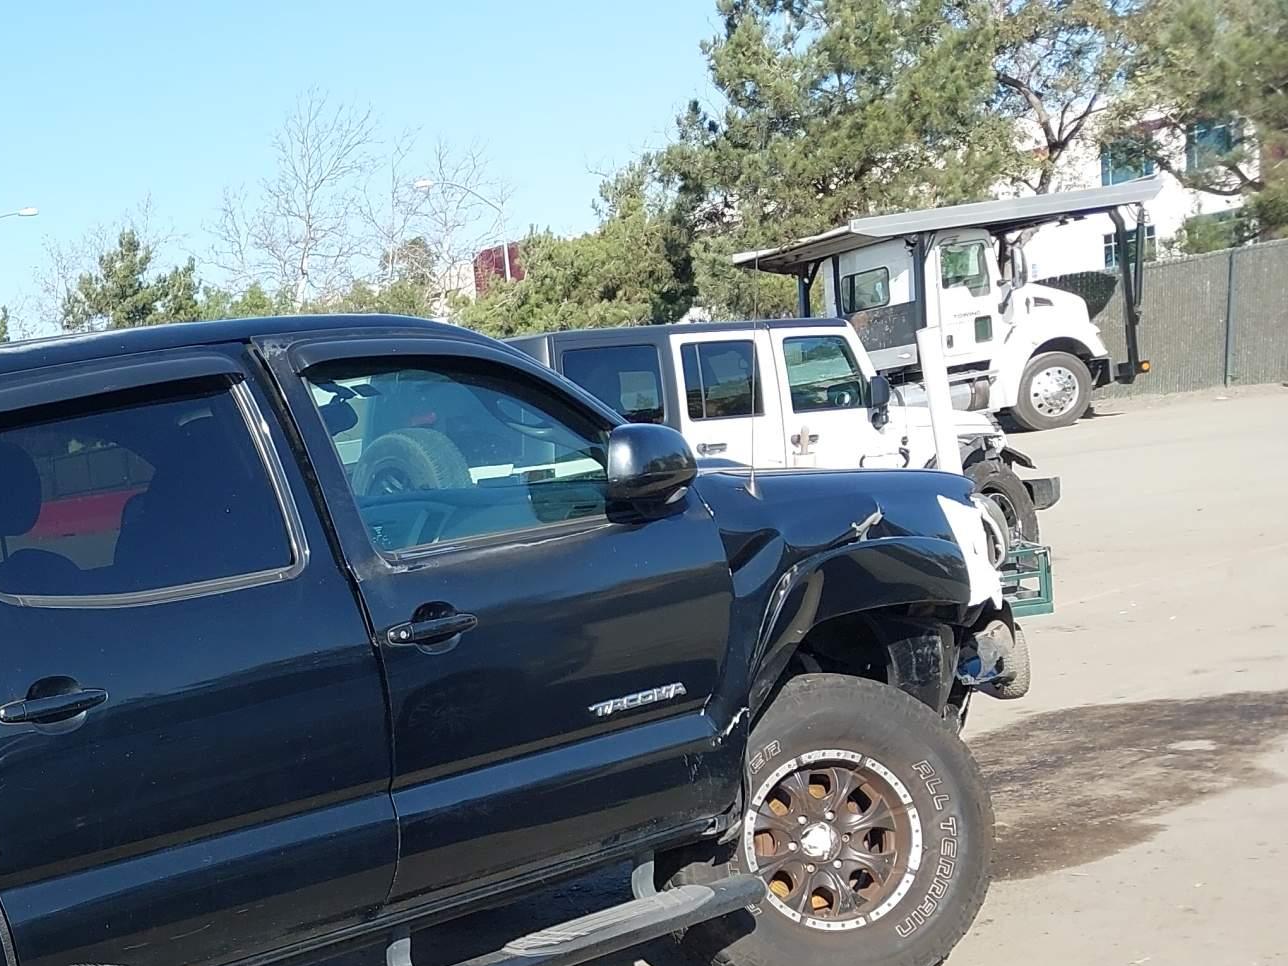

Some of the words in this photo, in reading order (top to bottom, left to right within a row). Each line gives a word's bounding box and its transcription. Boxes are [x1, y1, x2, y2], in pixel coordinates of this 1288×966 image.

[588, 681, 688, 717] TACOMA
[911, 759, 951, 812] ALL
[896, 815, 959, 939] TERRAIN
